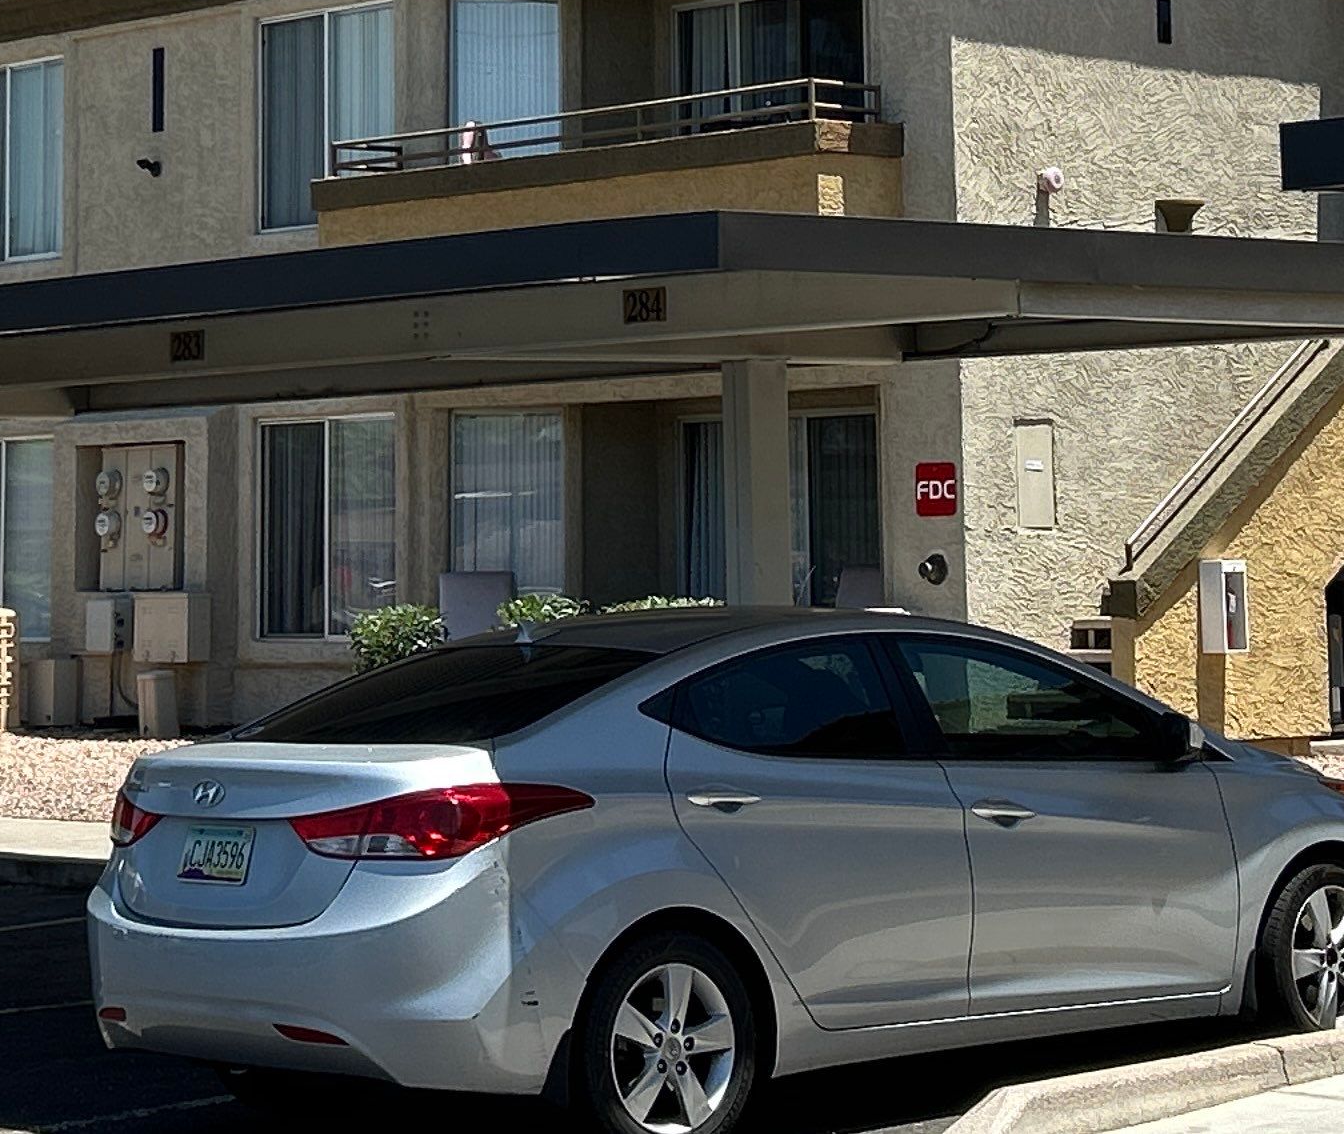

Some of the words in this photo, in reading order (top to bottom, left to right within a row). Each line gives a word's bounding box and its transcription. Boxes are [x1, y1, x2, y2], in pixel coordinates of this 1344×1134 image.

[626, 289, 663, 323] 284
[171, 331, 201, 361] 283
[916, 479, 956, 501] FDC
[188, 839, 247, 870] CJA3596
